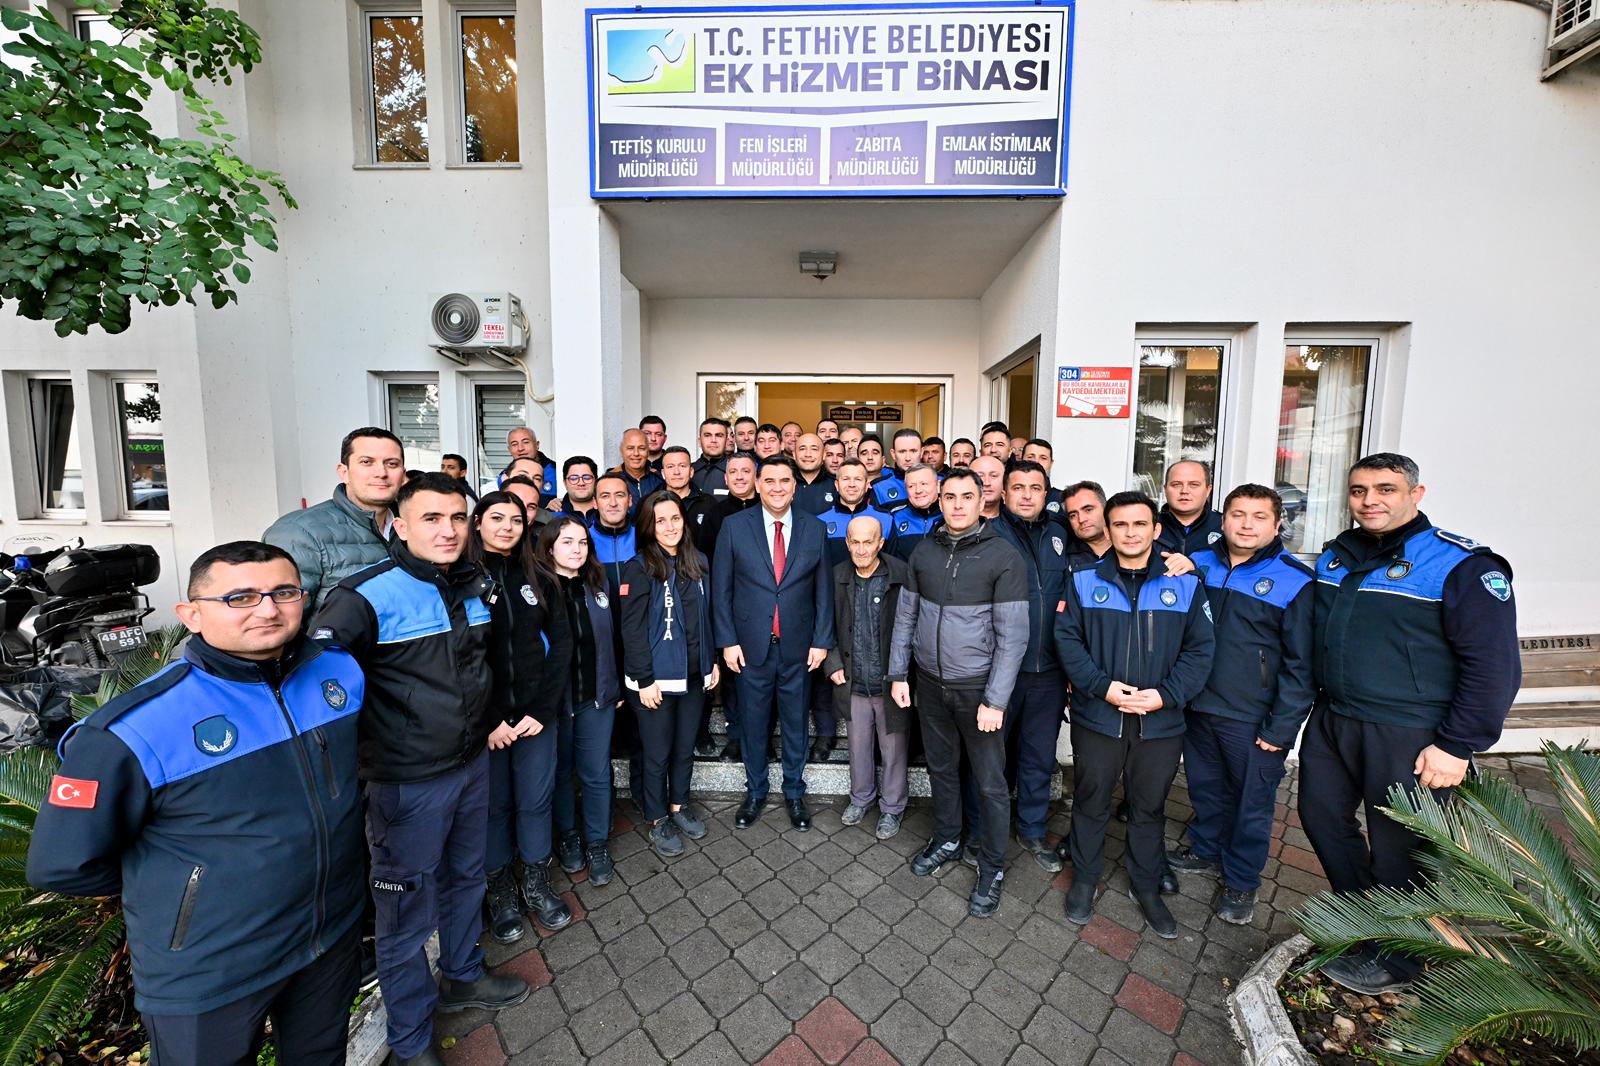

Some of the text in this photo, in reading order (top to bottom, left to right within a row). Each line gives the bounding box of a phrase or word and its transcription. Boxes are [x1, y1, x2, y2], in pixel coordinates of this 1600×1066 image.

[703, 27, 752, 56] T.C.
[703, 63, 755, 94] EK
[610, 136, 706, 159] TEFTİŞ KURULU
[739, 135, 808, 158] FEN İŞLERİ
[855, 136, 902, 153] ZABITA
[942, 132, 1052, 152] EMLAK İSTİMLAK
[618, 158, 698, 178] MÜDÜRLÜĞÜ
[732, 158, 814, 177] MÜDÜRLÜĞÜ
[836, 156, 919, 177] MÜDÜRLÜĞÜ
[954, 156, 1037, 176] MÜDÜRLÜĞÜ
[1061, 369, 1077, 379] 304
[102, 628, 142, 642] 48 AFC
[119, 636, 142, 647] 591
[1521, 635, 1591, 649] LEDİYESİ
[374, 880, 404, 892] ZABITA
